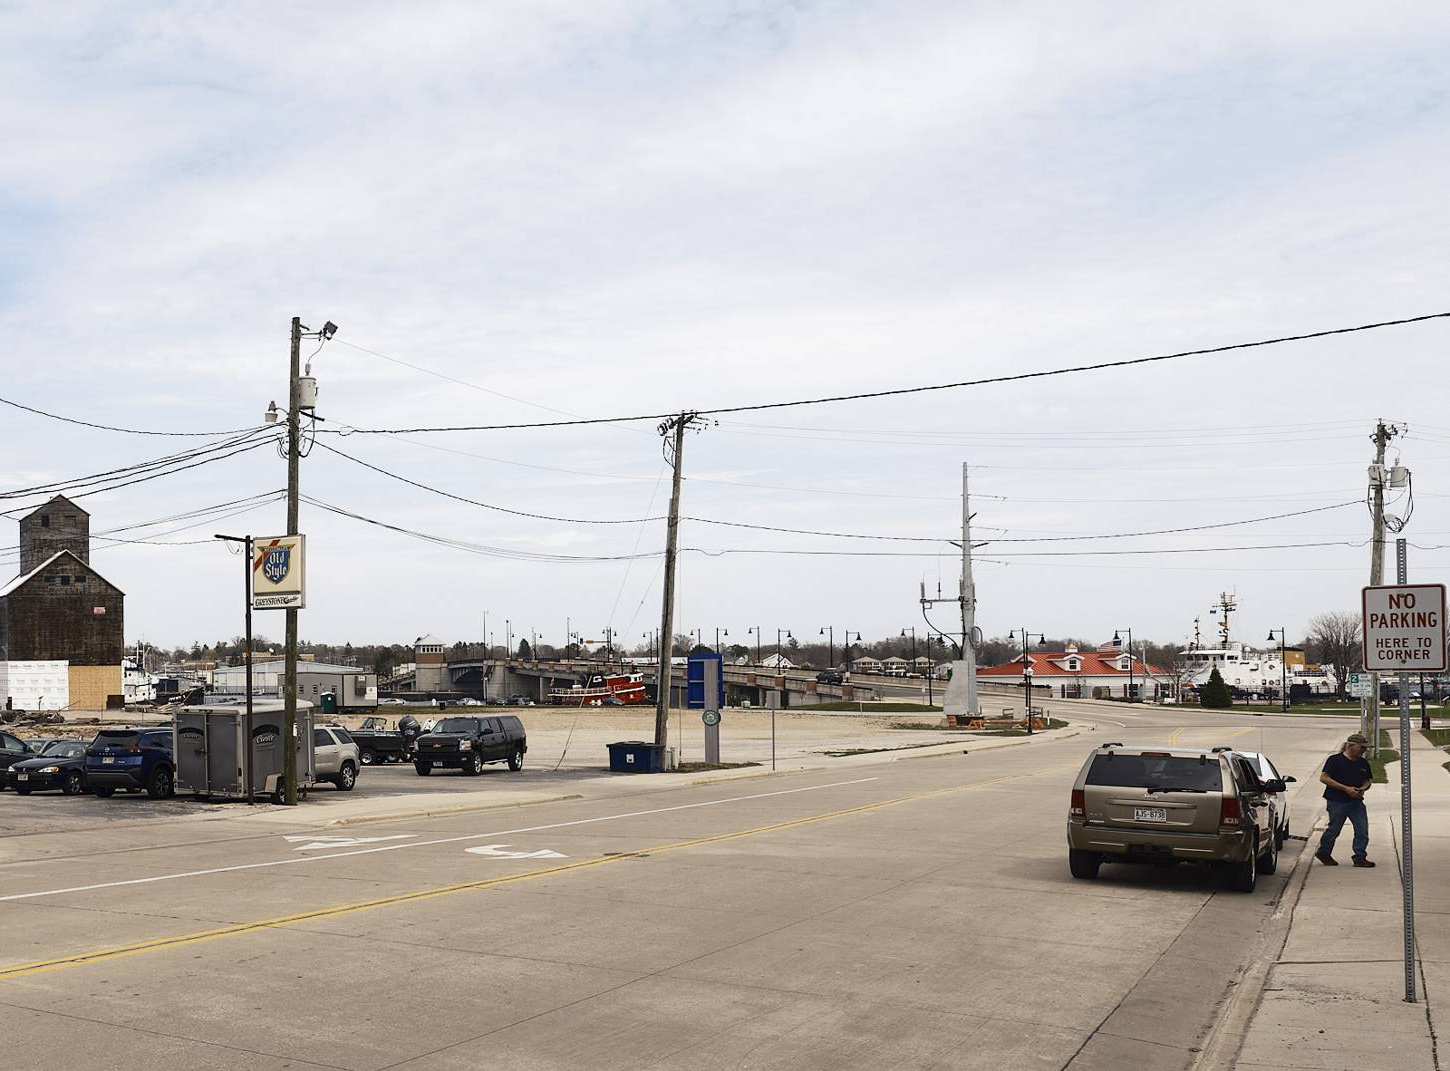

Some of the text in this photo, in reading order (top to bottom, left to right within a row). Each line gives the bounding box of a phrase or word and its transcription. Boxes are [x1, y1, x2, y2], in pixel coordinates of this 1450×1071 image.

[270, 552, 285, 565] Old
[265, 563, 287, 580] Style
[1388, 593, 1416, 609] NO
[1370, 611, 1437, 628] PARKING
[1376, 637, 1432, 648] HERE TO
[1378, 649, 1430, 660] CORNER
[1351, 675, 1357, 683] 2
